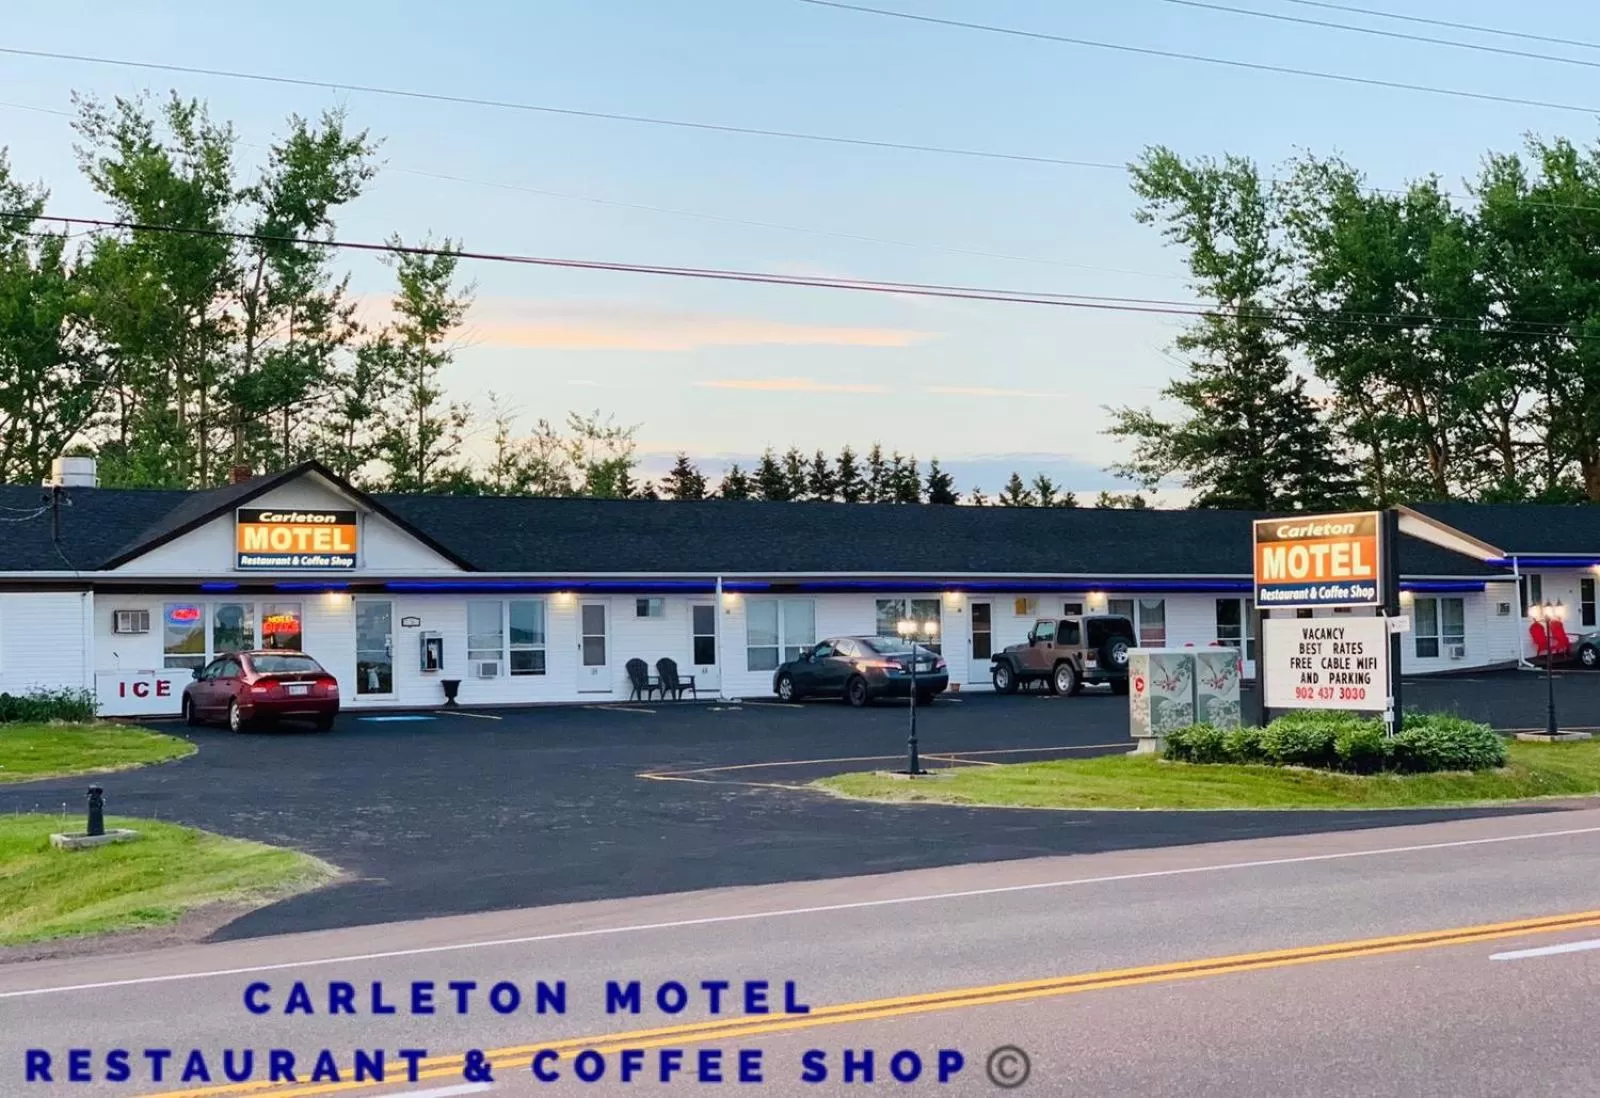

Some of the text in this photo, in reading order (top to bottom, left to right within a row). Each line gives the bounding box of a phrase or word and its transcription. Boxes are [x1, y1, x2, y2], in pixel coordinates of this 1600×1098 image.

[259, 512, 336, 523] Carleton
[1276, 523, 1355, 538] Carleton
[244, 526, 350, 551] MOTEL
[241, 555, 353, 567] Restaurant & Coffee Shop
[1263, 541, 1371, 579] MOTEL
[1260, 584, 1375, 601] Restaurant & Coffee Shop
[1302, 627, 1345, 640] VACANCY
[1299, 642, 1363, 655] BEST RATES
[1290, 657, 1377, 669] FREE CABLE WIFI
[1300, 672, 1371, 685] AND PARKING
[119, 680, 171, 698] ICE
[1295, 687, 1366, 700] 902 437 3030
